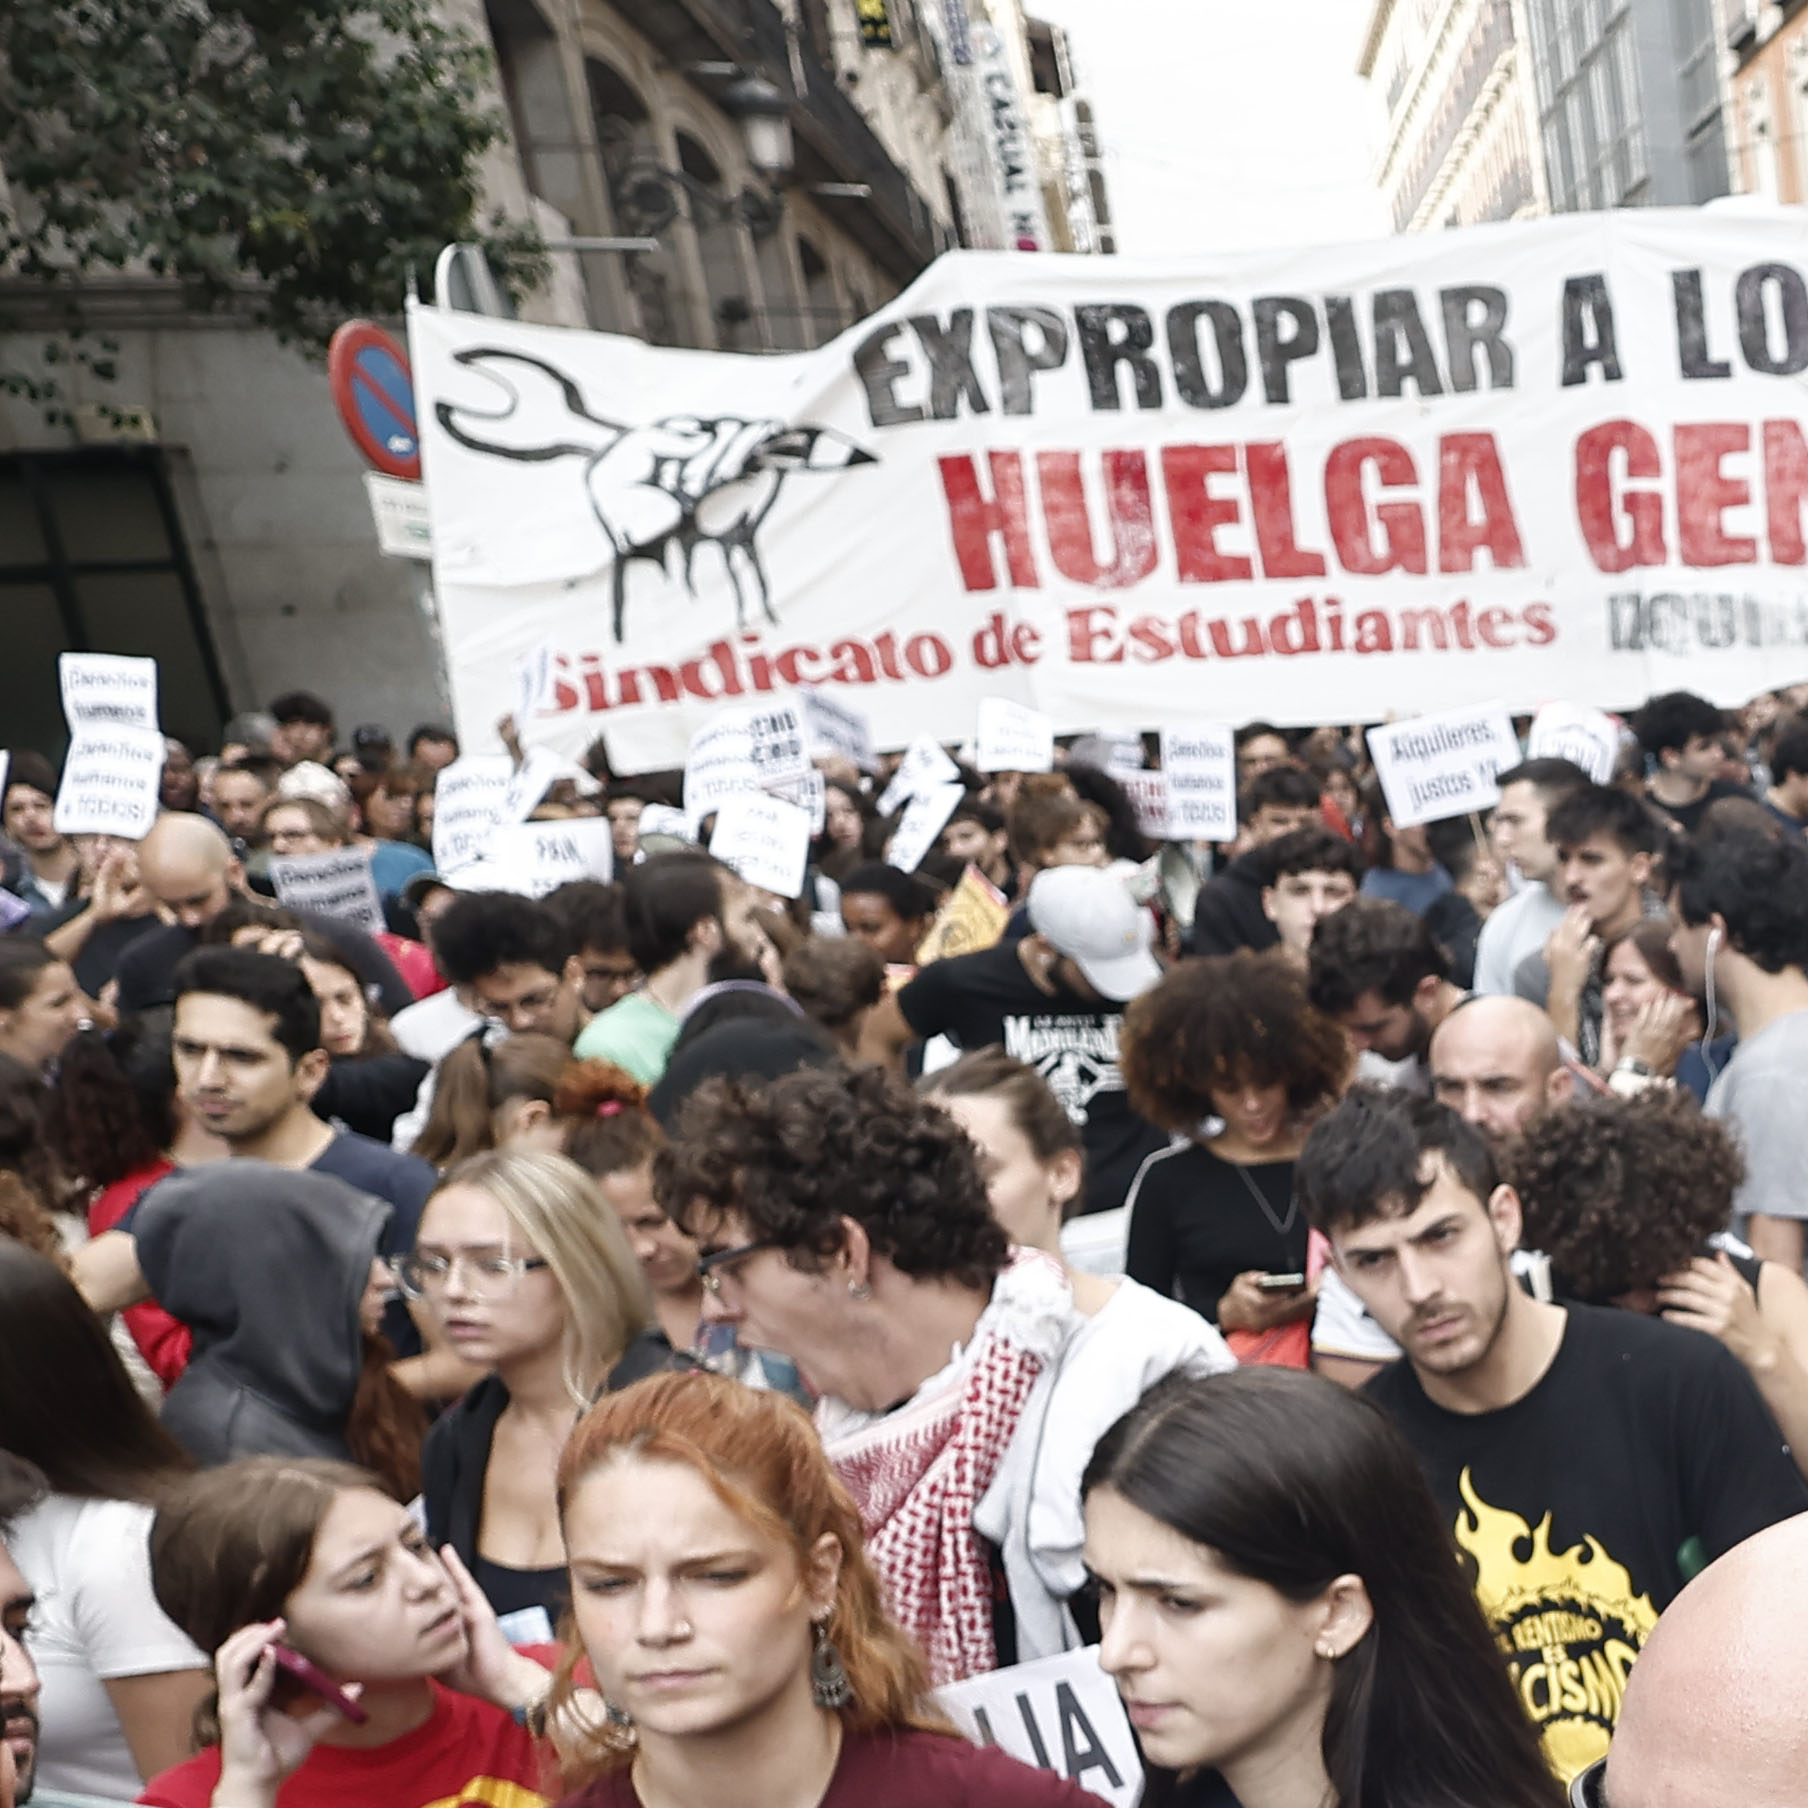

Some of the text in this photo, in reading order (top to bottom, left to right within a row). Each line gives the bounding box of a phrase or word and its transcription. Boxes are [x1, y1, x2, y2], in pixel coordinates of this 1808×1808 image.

[852, 283, 1516, 428] EXPROPIAR
[1561, 272, 1626, 388] A
[936, 430, 1527, 594] HUELGA
[546, 630, 954, 714] Sindicato
[971, 610, 1042, 671] de
[1064, 592, 1557, 666] Estudiantes
